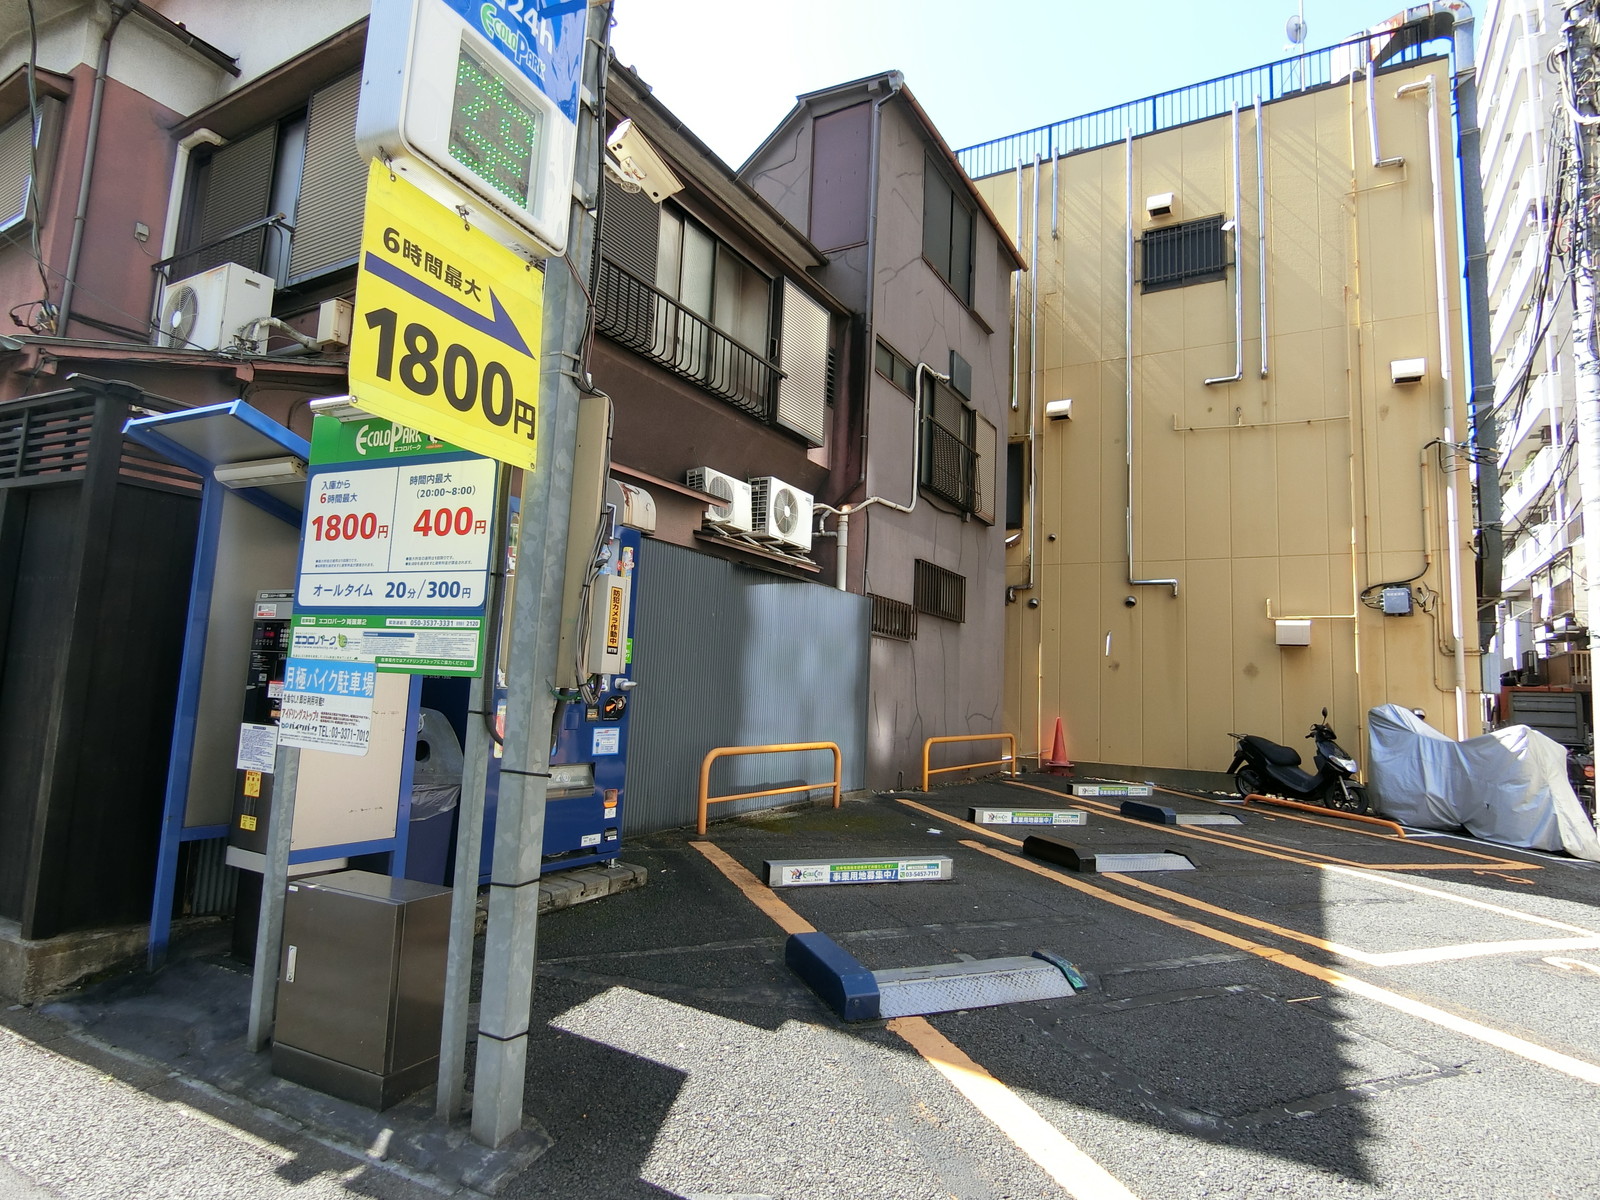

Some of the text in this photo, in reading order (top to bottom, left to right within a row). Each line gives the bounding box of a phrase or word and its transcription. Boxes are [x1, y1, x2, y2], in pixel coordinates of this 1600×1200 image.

[382, 226, 482, 303] 6時間最大
[365, 307, 536, 441] 1800円
[395, 444, 421, 452] エコロパーク
[321, 479, 351, 490] 入庫から
[409, 473, 452, 485] 時間内最大
[320, 492, 358, 504] 6時間最大
[312, 512, 389, 541] 1800円
[413, 506, 487, 537] 400円
[313, 583, 373, 597] オールタイム
[609, 589, 620, 644] 防犯カメラ作動中
[294, 634, 337, 645] エコロパーク
[285, 666, 375, 697] 月極バイク駐車場
